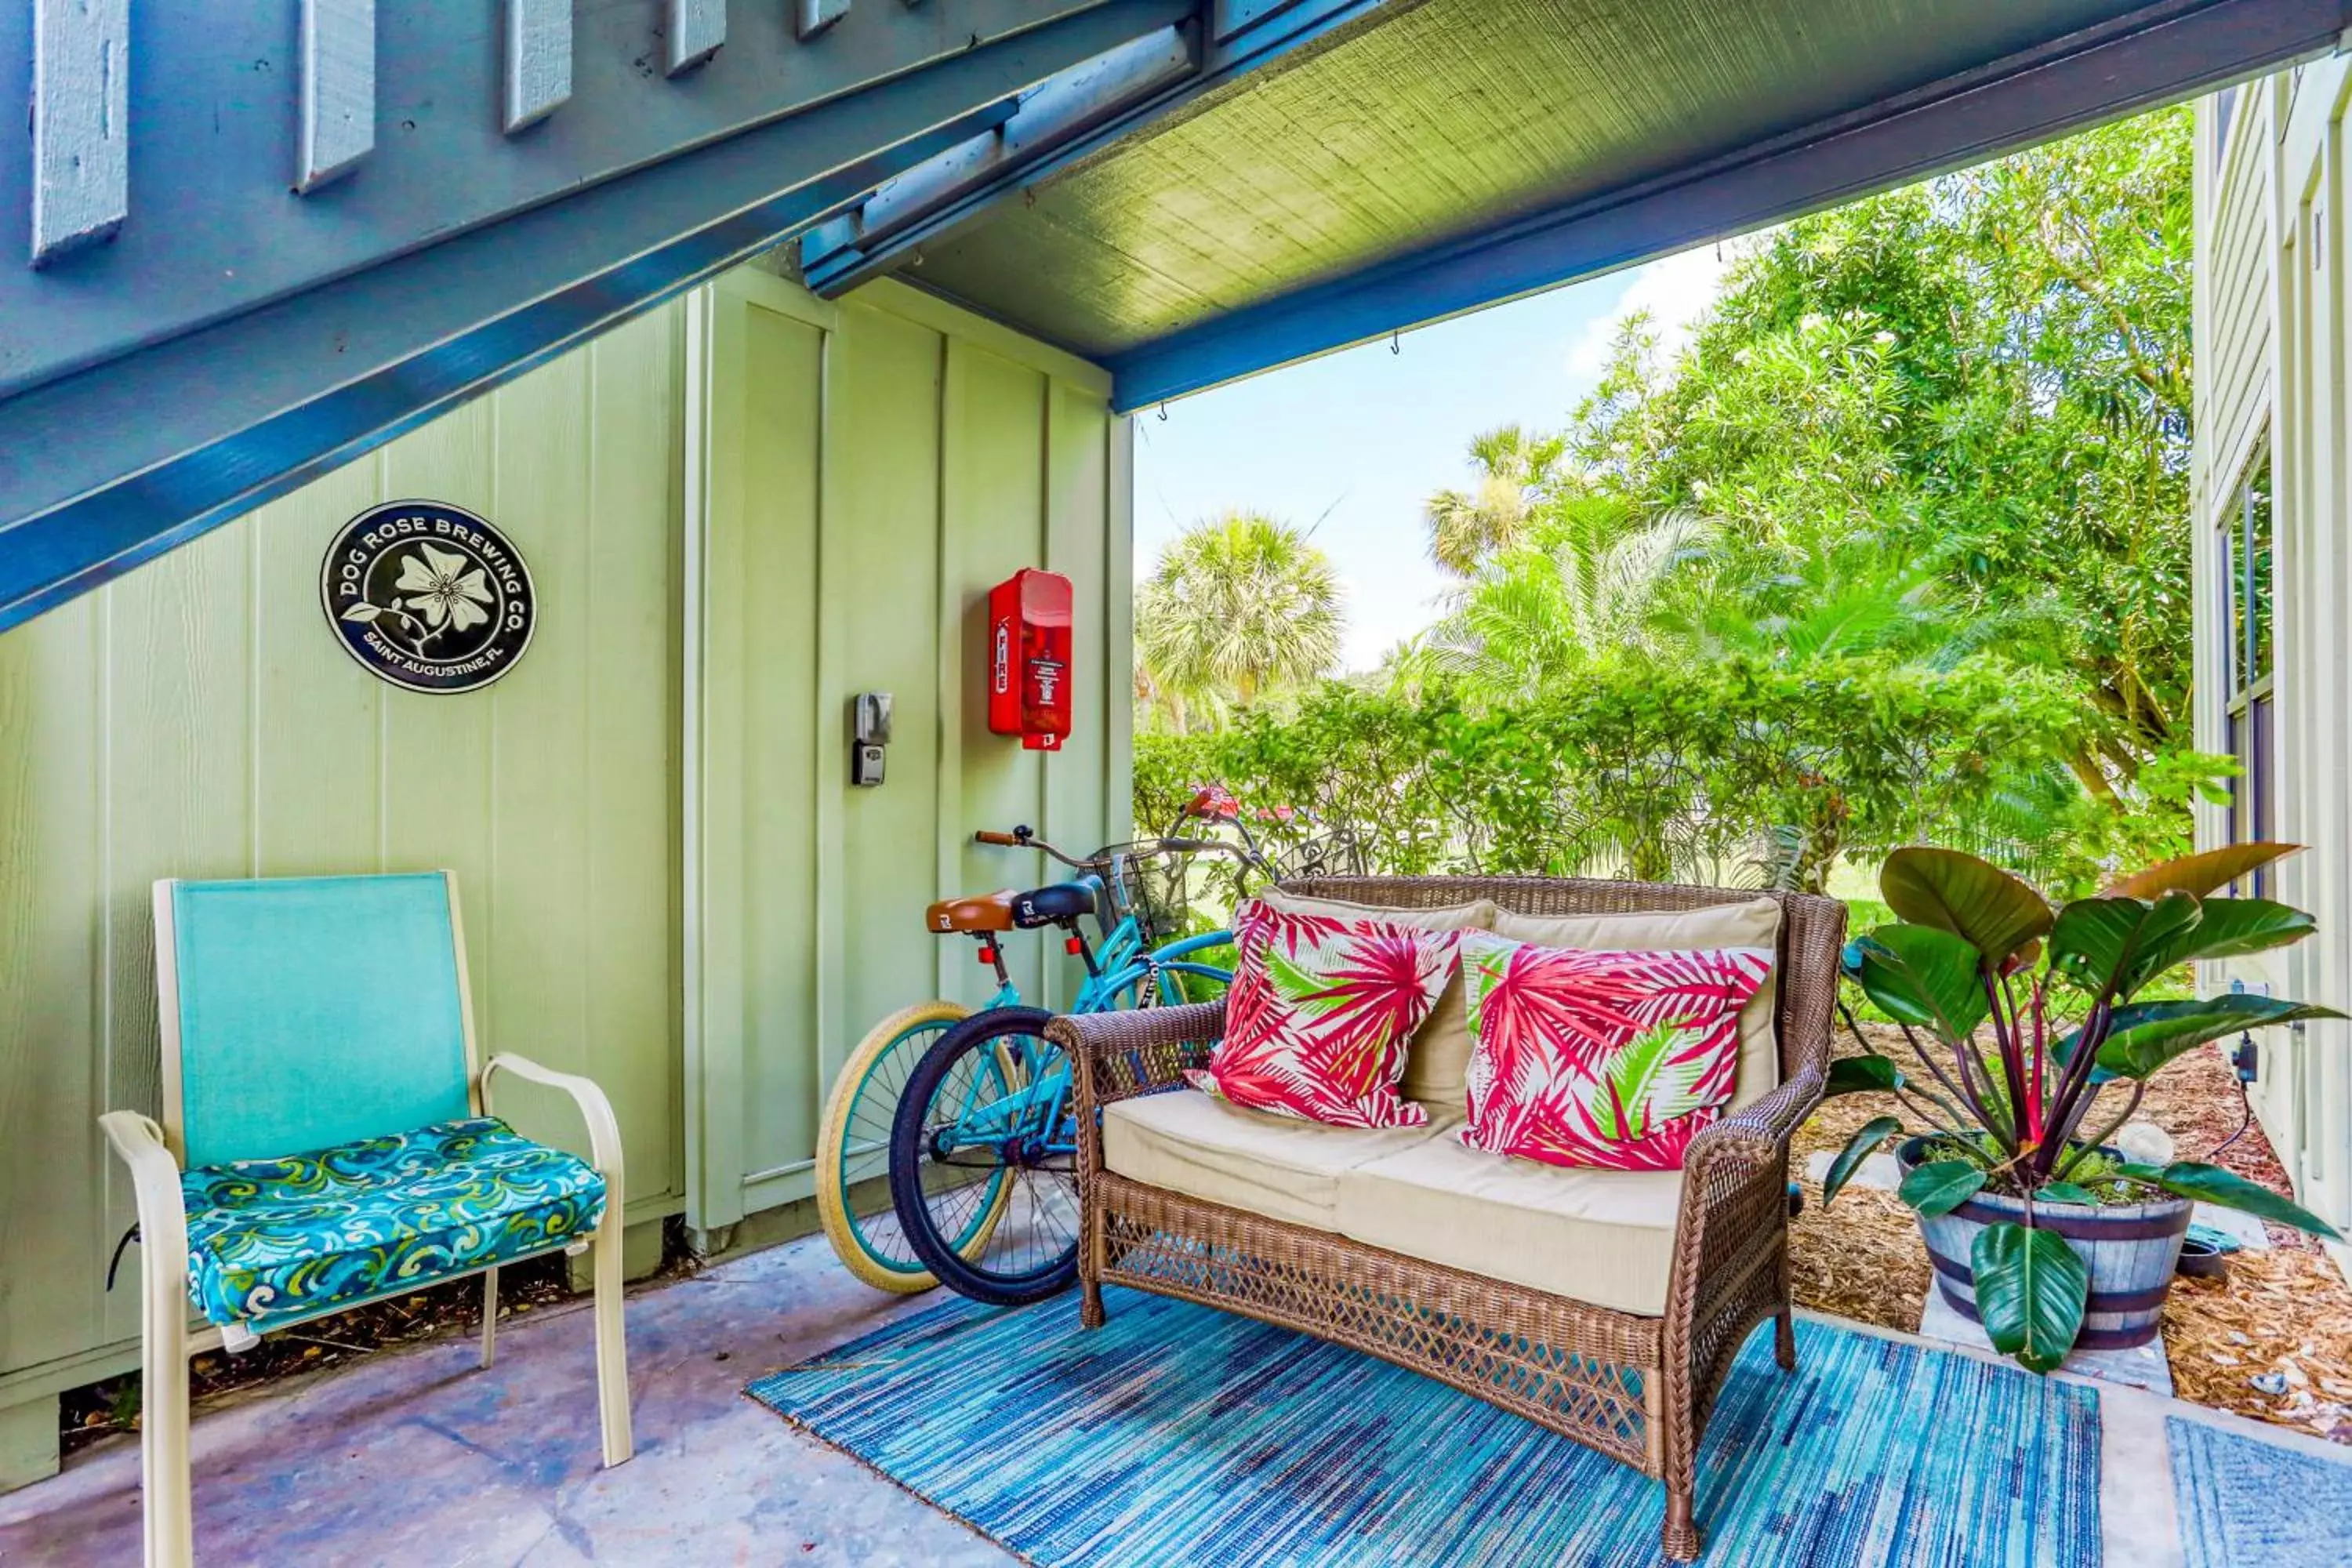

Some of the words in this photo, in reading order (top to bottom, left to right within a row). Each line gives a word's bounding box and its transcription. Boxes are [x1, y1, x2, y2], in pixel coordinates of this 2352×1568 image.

[339, 549, 368, 596] DOG
[362, 517, 428, 549] ROSE
[435, 518, 522, 593] BREWING
[505, 600, 525, 632] CO.
[363, 631, 405, 664] SAINT
[487, 647, 504, 662] FL
[997, 635, 1007, 689] FIRE
